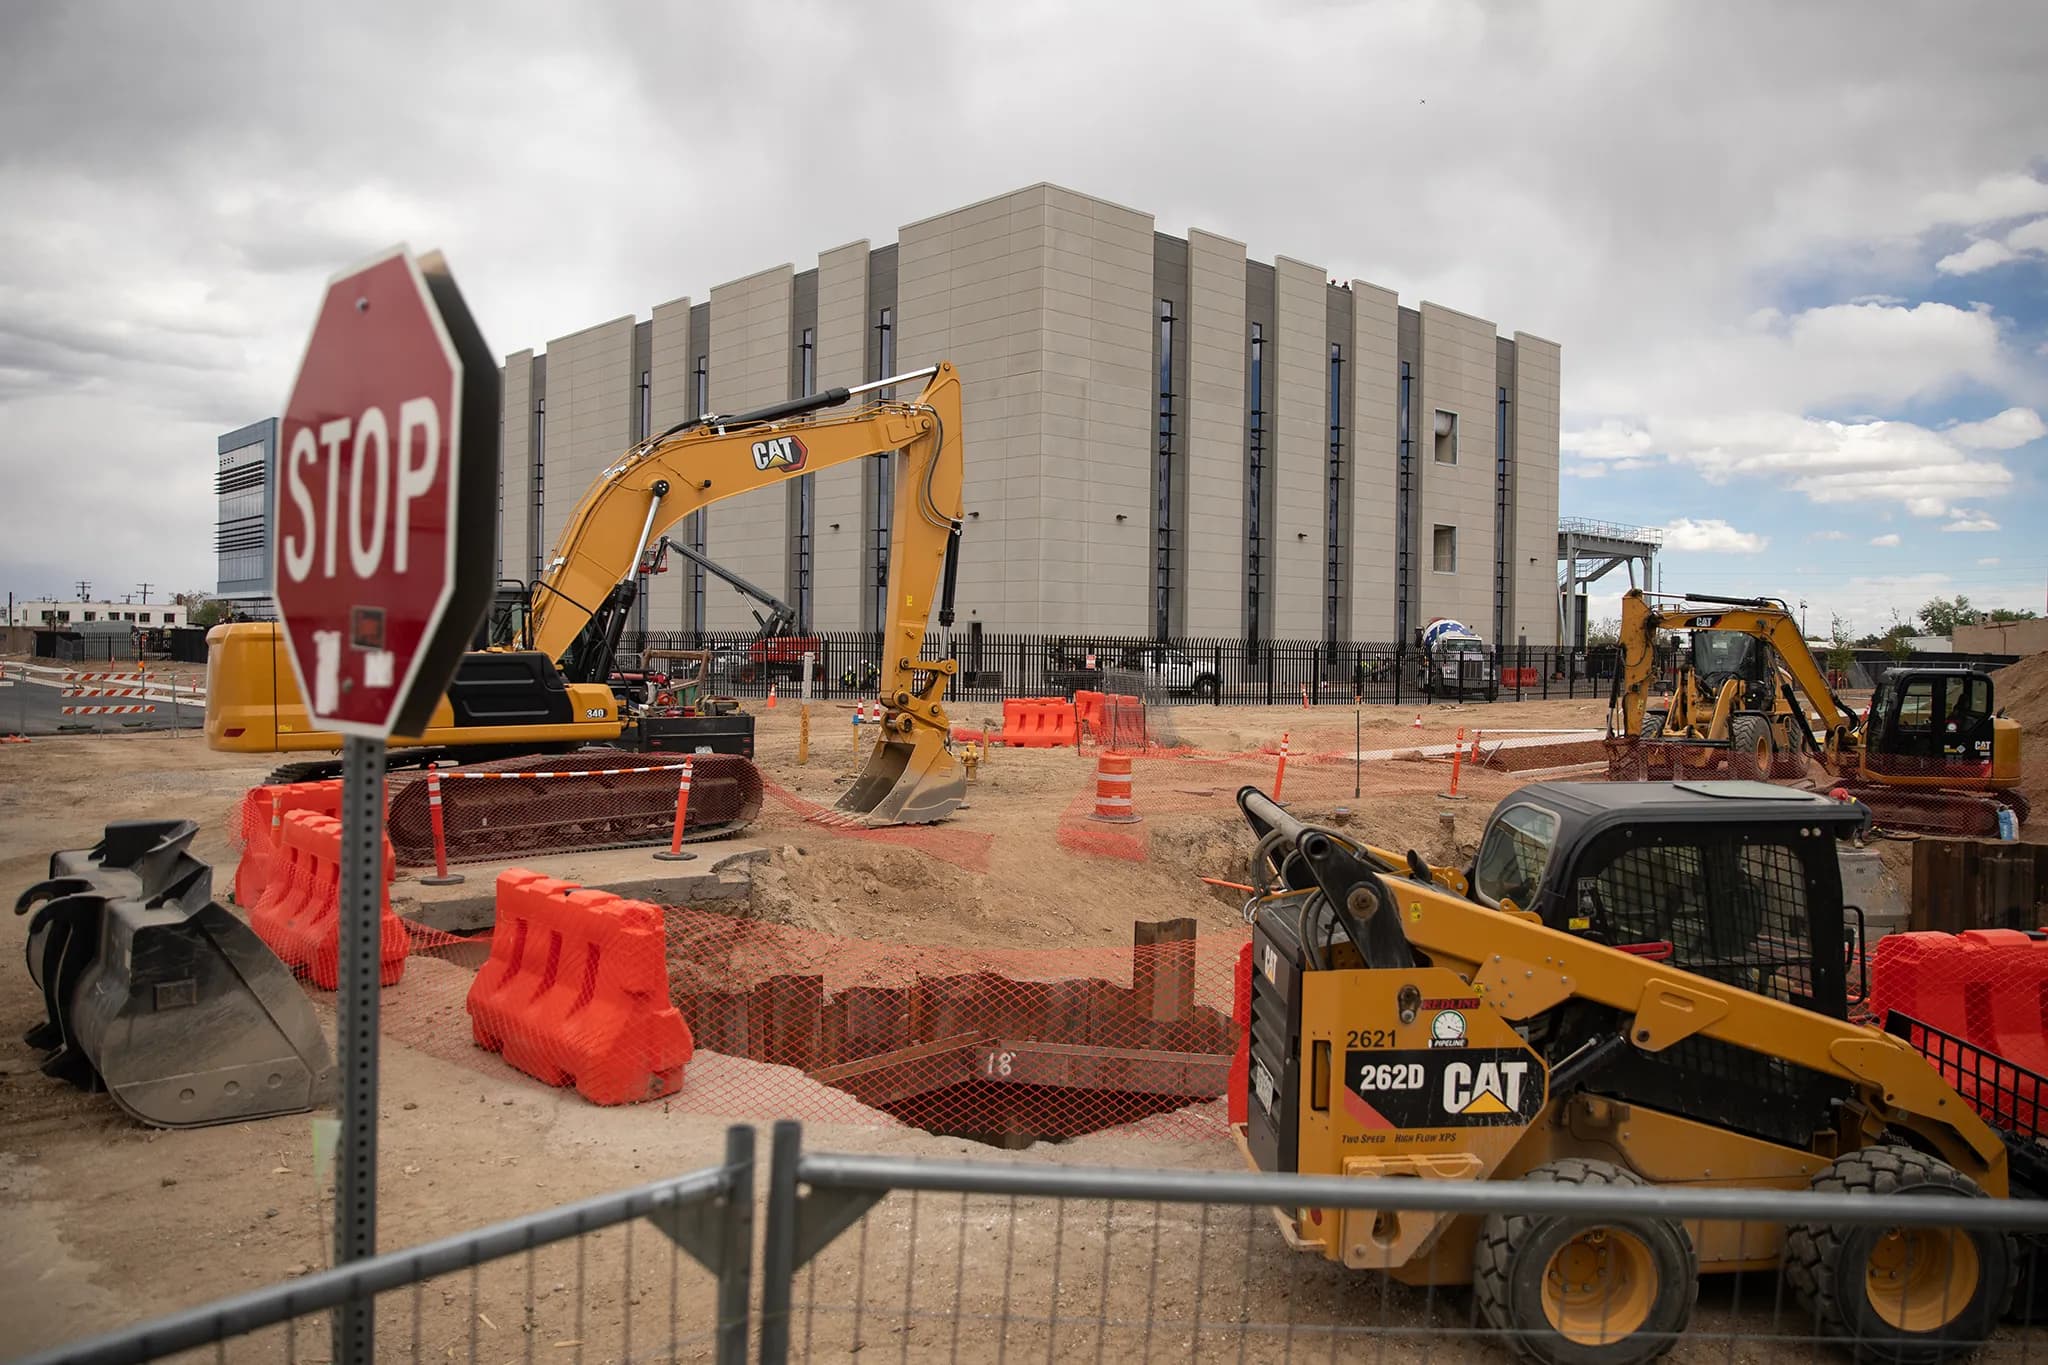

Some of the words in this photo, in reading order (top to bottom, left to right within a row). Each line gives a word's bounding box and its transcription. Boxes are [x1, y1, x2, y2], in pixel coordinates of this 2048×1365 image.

[752, 436, 794, 470] CAT
[284, 396, 440, 582] STOP
[1696, 617, 1712, 627] CAT
[1974, 741, 1991, 750] CAT
[1421, 999, 1480, 1009] REDLINE
[1346, 1030, 1396, 1048] 2621
[1433, 1039, 1465, 1047] PIPELINE
[1360, 1064, 1424, 1090] 262D
[1443, 1062, 1528, 1114] CAT
[1438, 1132, 1456, 1142] XPS
